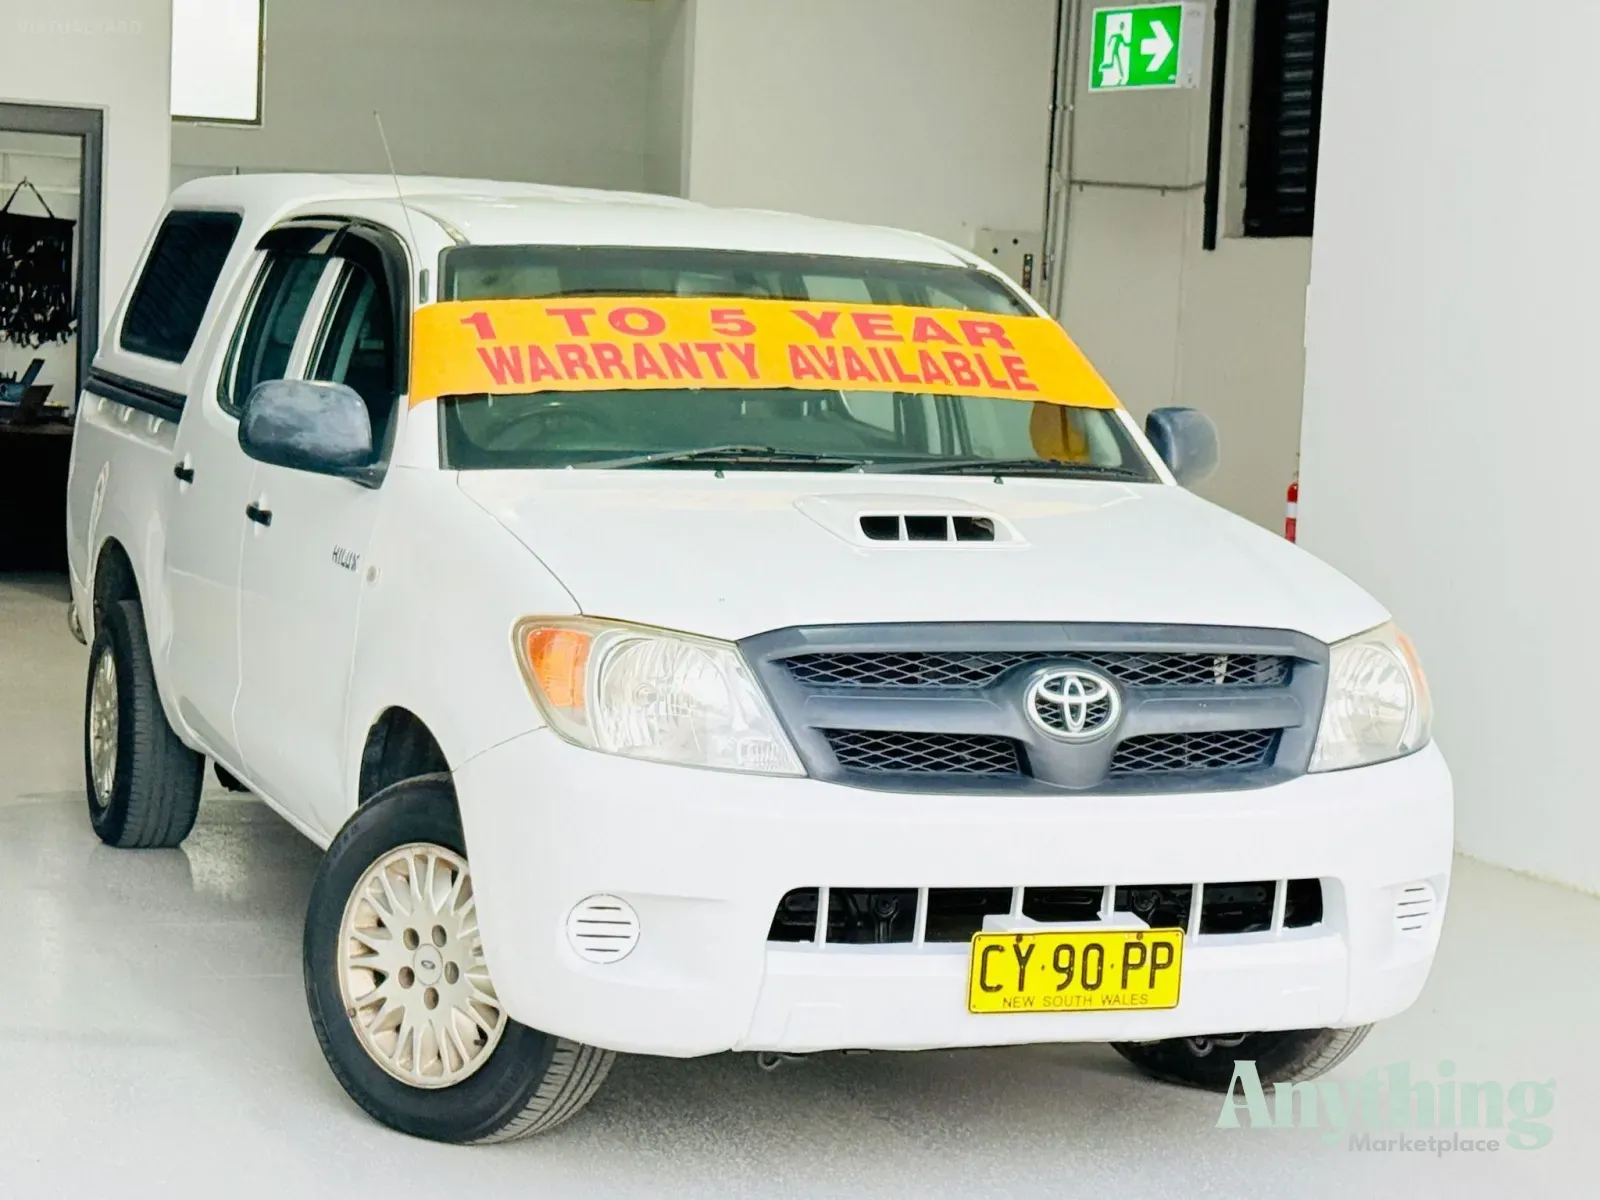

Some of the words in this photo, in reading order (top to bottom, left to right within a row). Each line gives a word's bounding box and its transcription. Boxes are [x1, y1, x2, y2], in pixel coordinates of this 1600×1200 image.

[460, 311, 497, 340] 1
[545, 307, 667, 337] TO
[711, 308, 757, 337] 5
[790, 309, 1016, 350] YEAR
[476, 342, 761, 386] WARRANTY
[788, 344, 1039, 392] AVAILABLE
[1003, 995, 1036, 1008] NEW
[1043, 994, 1092, 1007] SOUTH
[1100, 993, 1149, 1006] WALES
